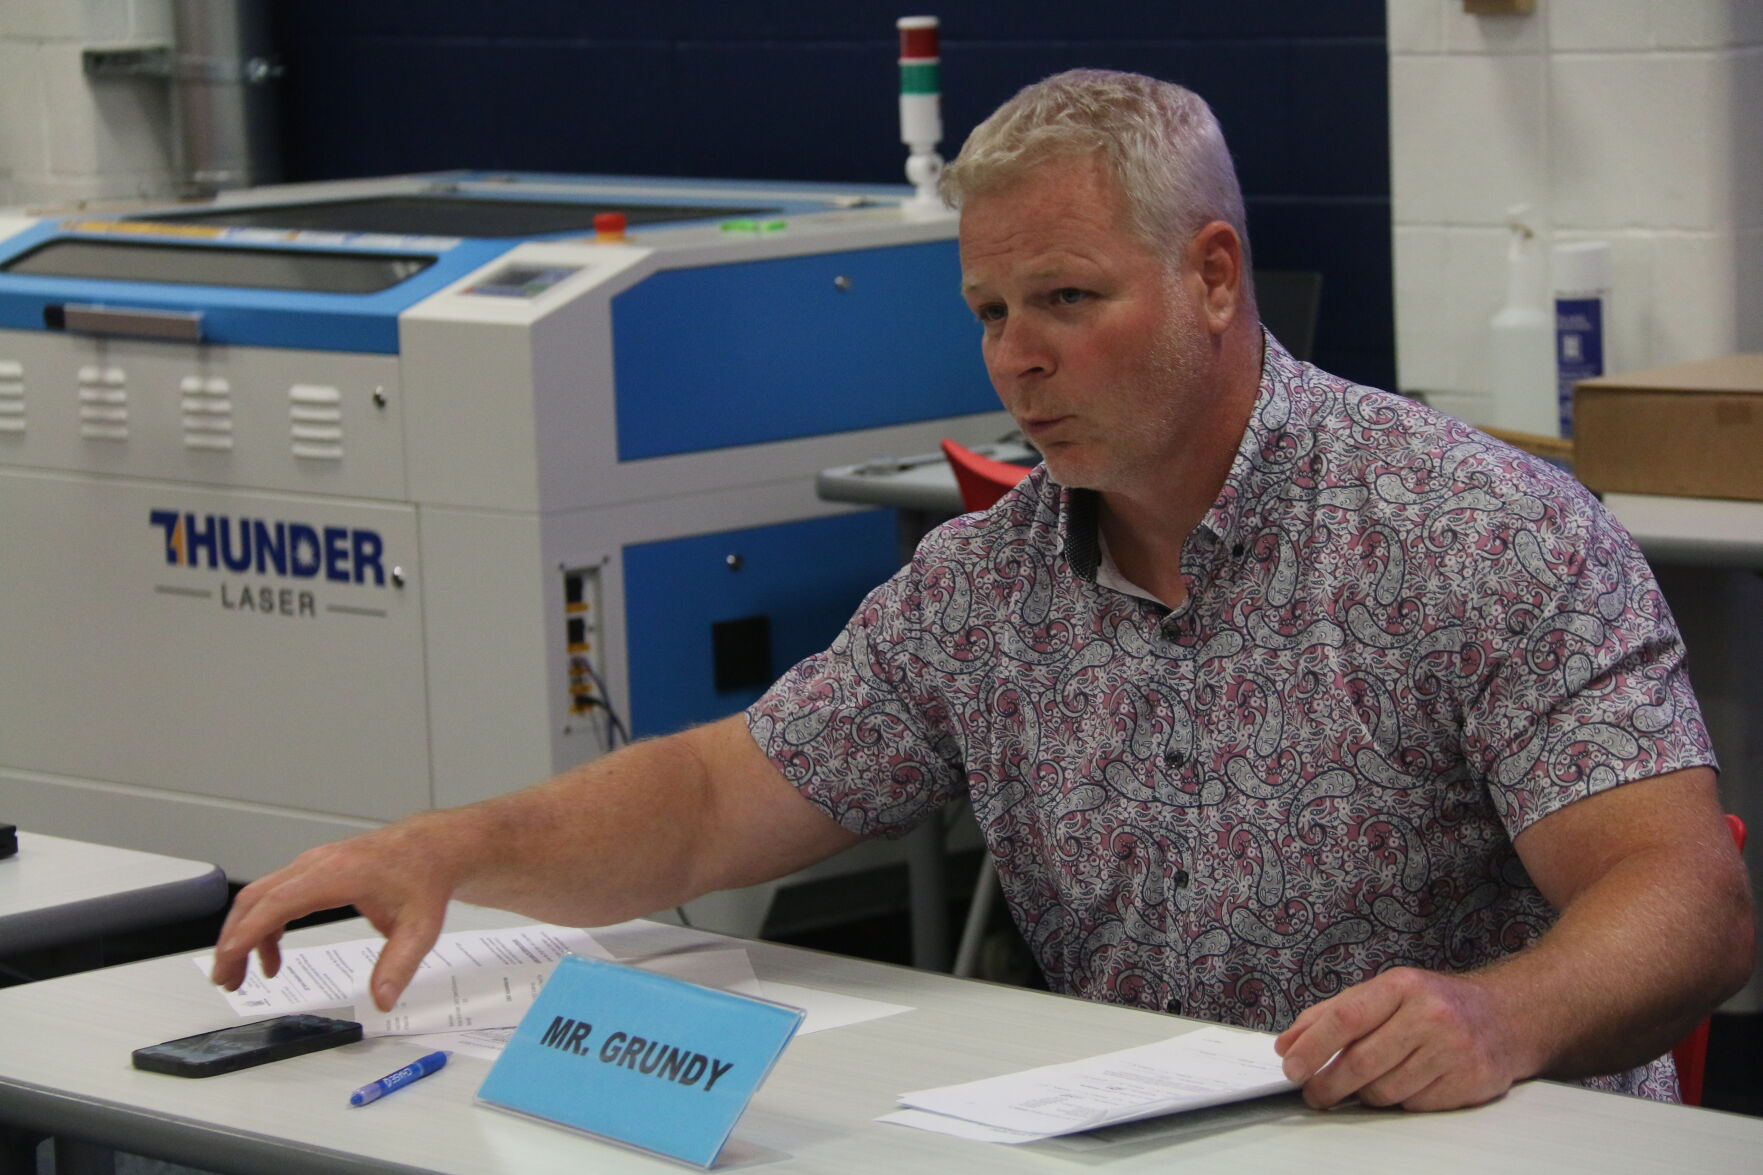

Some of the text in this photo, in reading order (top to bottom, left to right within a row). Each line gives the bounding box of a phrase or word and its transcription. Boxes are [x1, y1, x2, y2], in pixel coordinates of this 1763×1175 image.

[150, 509, 386, 586] THUNDER
[220, 584, 316, 617] LASER
[540, 1016, 733, 1092] MR. GRUNDY
